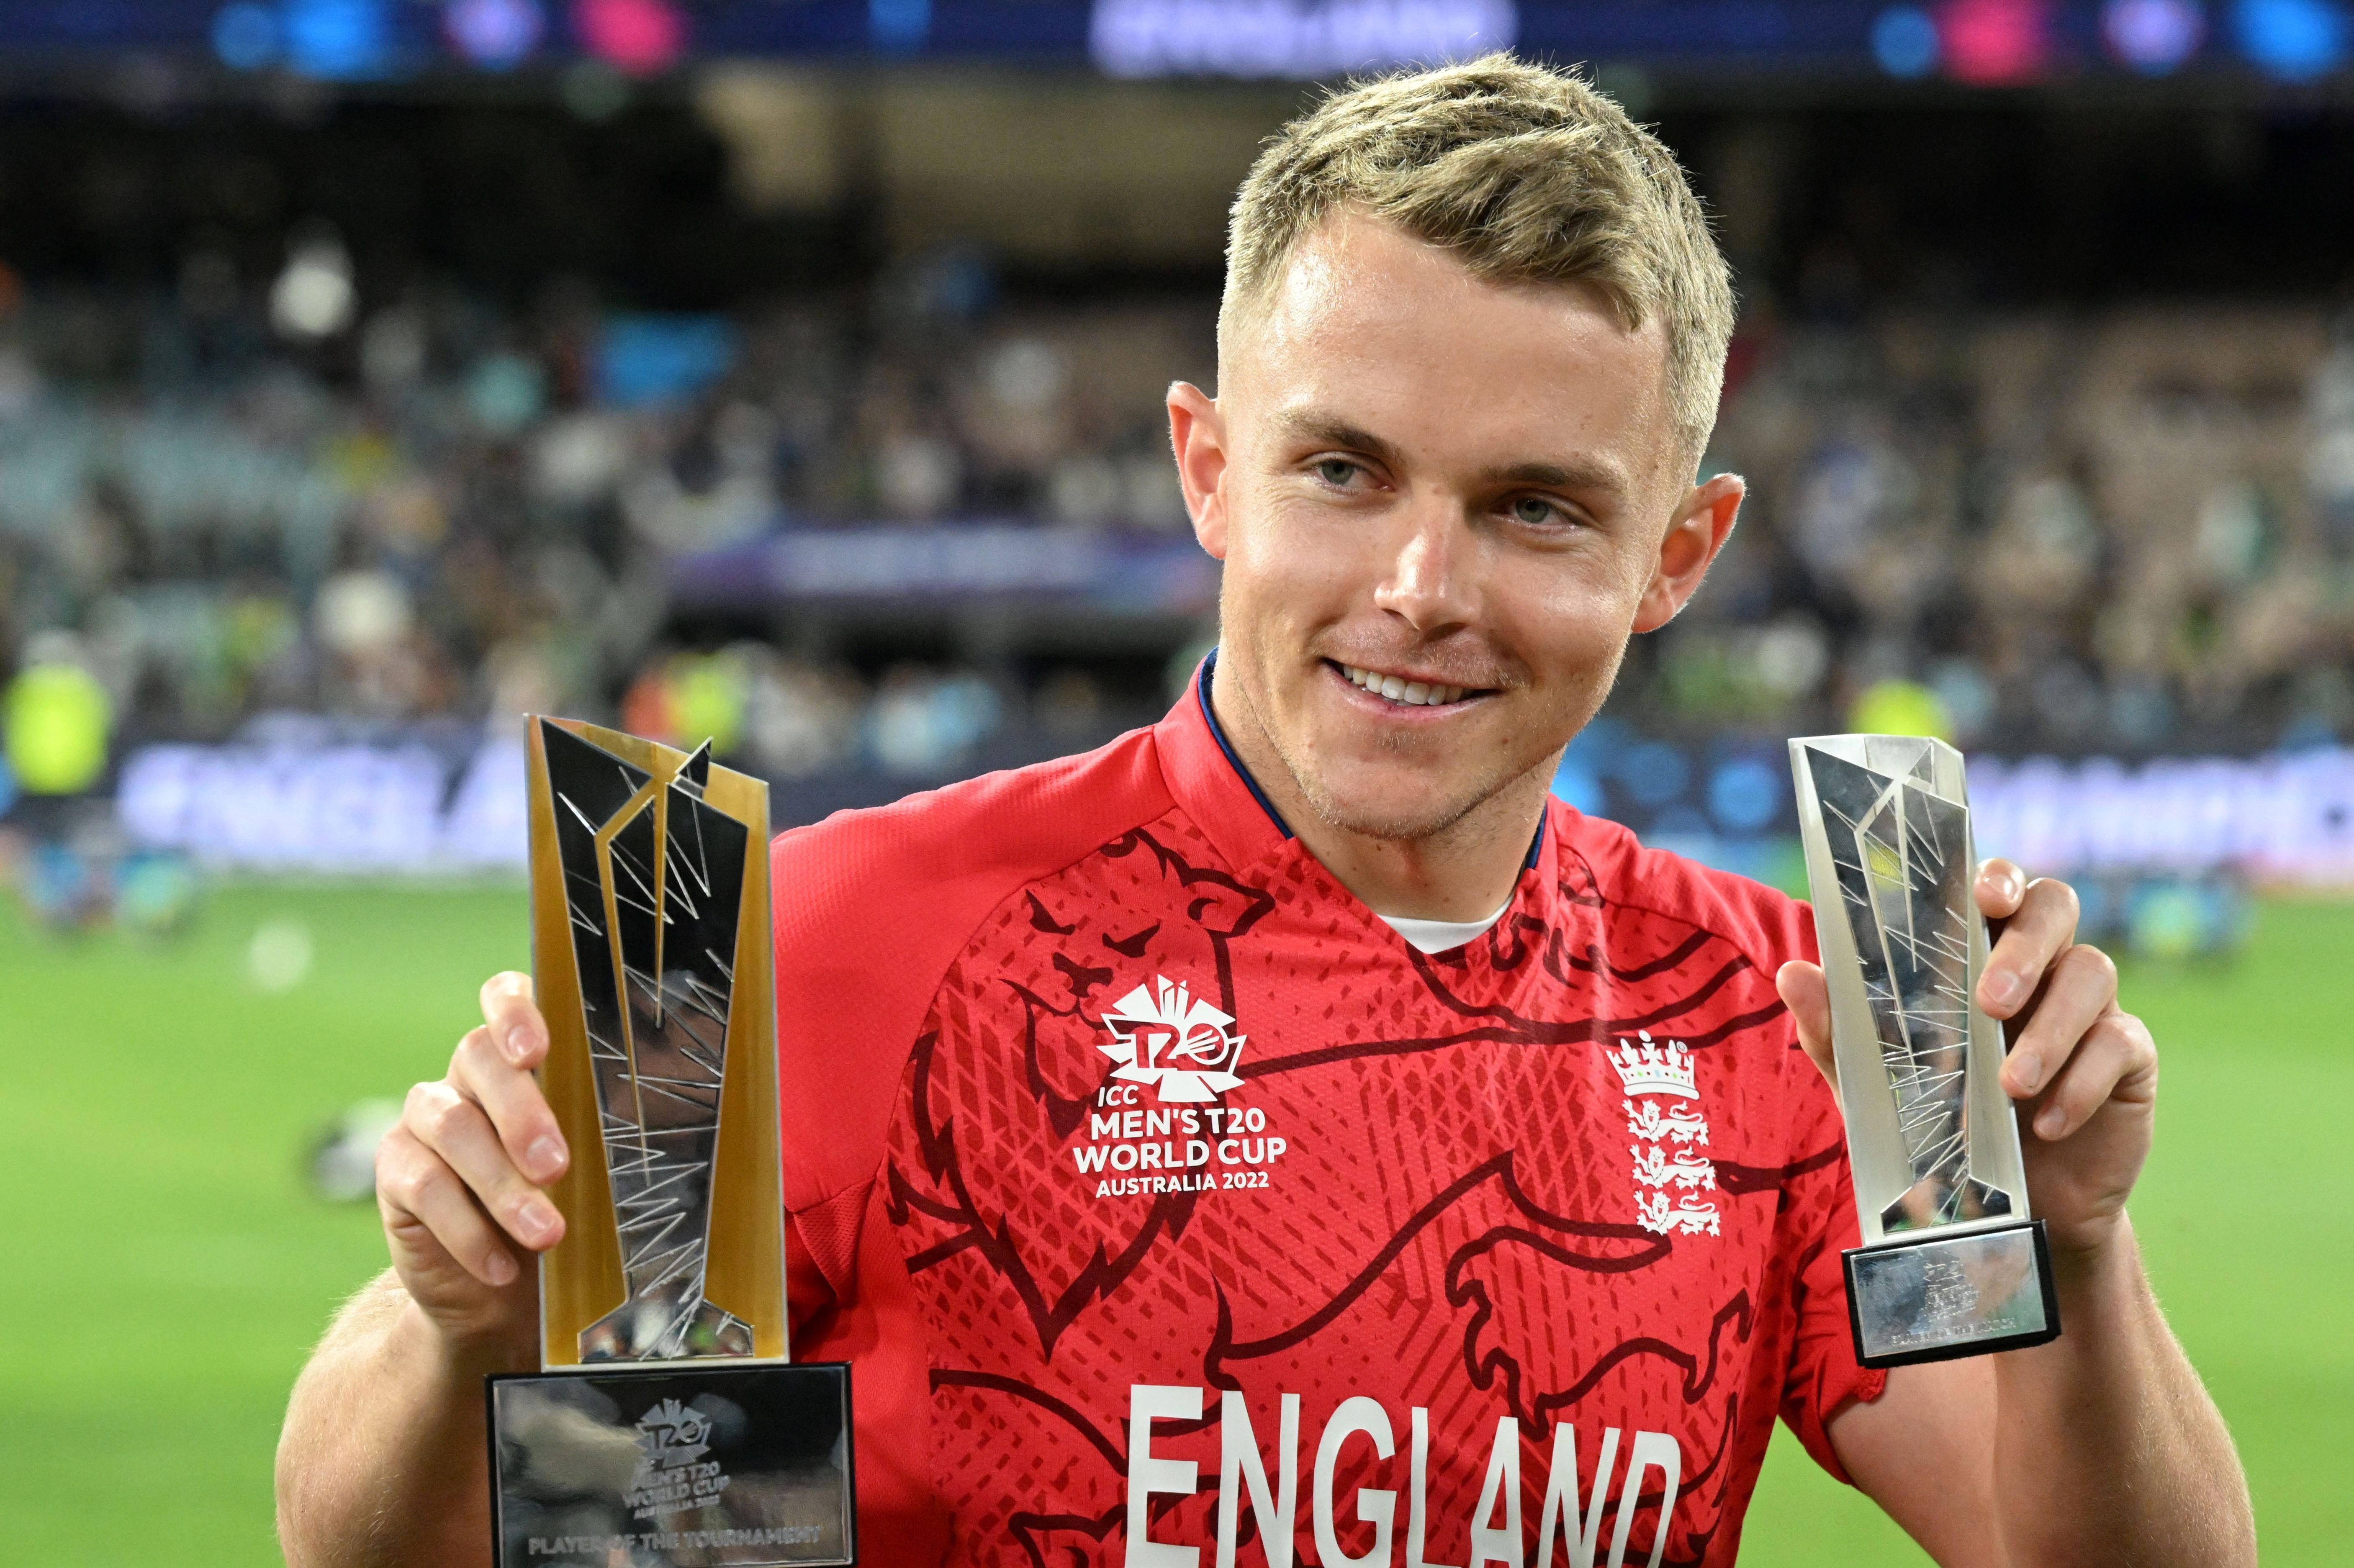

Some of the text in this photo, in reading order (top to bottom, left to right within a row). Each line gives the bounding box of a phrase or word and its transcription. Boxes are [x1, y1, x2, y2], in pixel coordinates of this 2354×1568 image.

[1097, 1085, 1139, 1107] ICC
[1091, 1108, 1265, 1140] MEN'S T20
[1073, 1137, 1287, 1173] WORLD CUP
[1096, 1172, 1269, 1198] AUSTRALIA 2022
[687, 1460, 720, 1480] T20
[1124, 1384, 1681, 1568] ENGLAND
[622, 1475, 731, 1509] WORLD CUP
[528, 1525, 820, 1555] PLAYER OF THE TOURNAMENT
